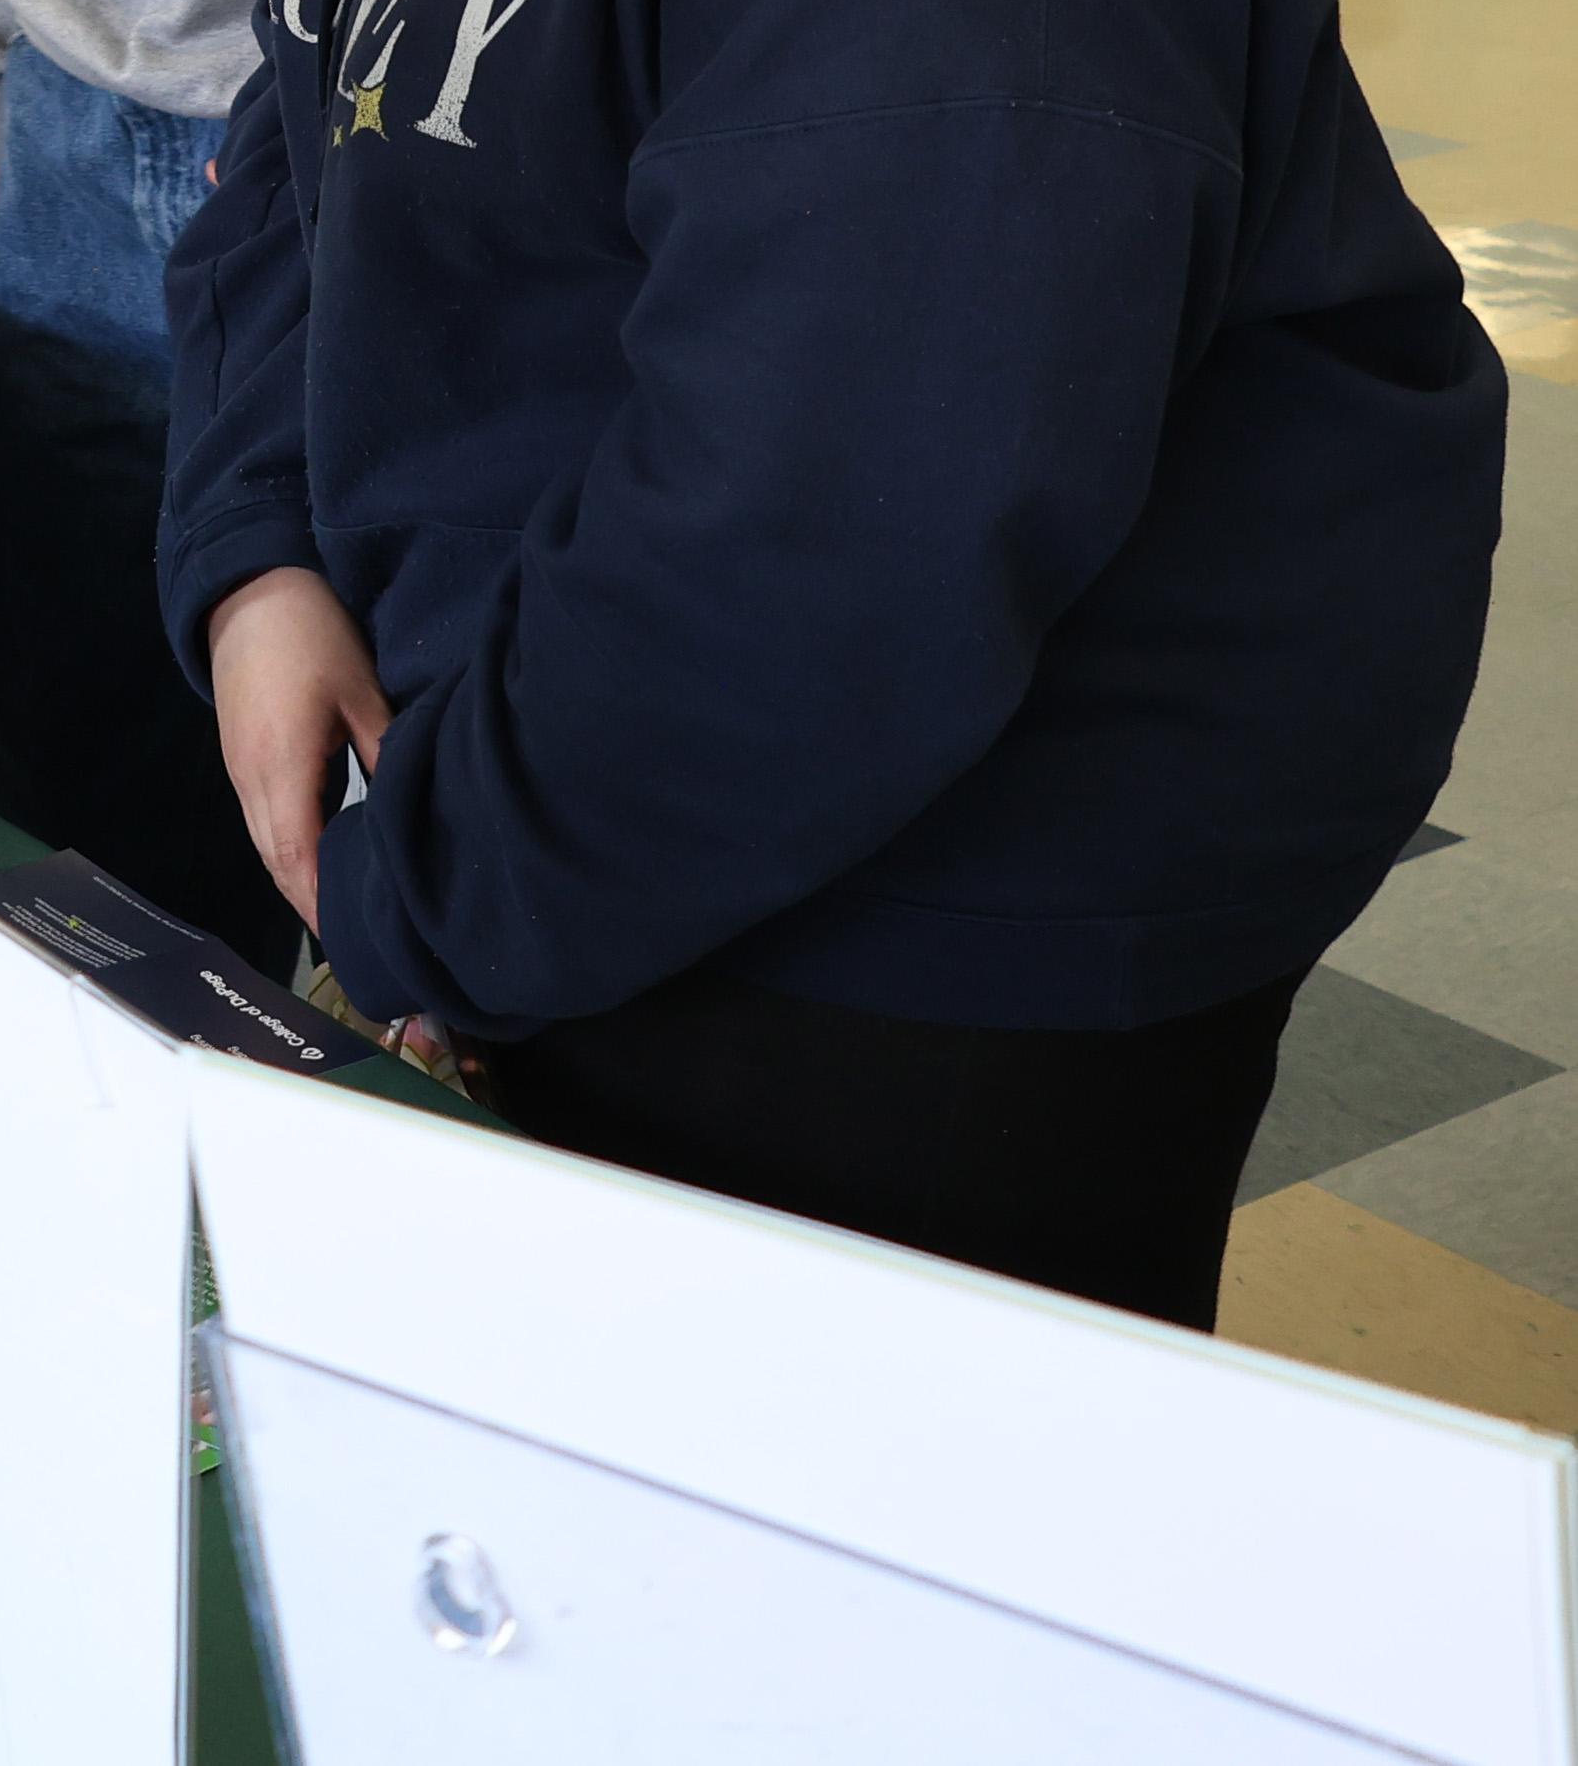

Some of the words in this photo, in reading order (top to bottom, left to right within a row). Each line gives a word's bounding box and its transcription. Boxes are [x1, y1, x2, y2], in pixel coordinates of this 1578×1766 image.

[199, 970, 248, 1007] DuPage
[240, 1005, 262, 1021] of
[258, 1015, 306, 1047] College
